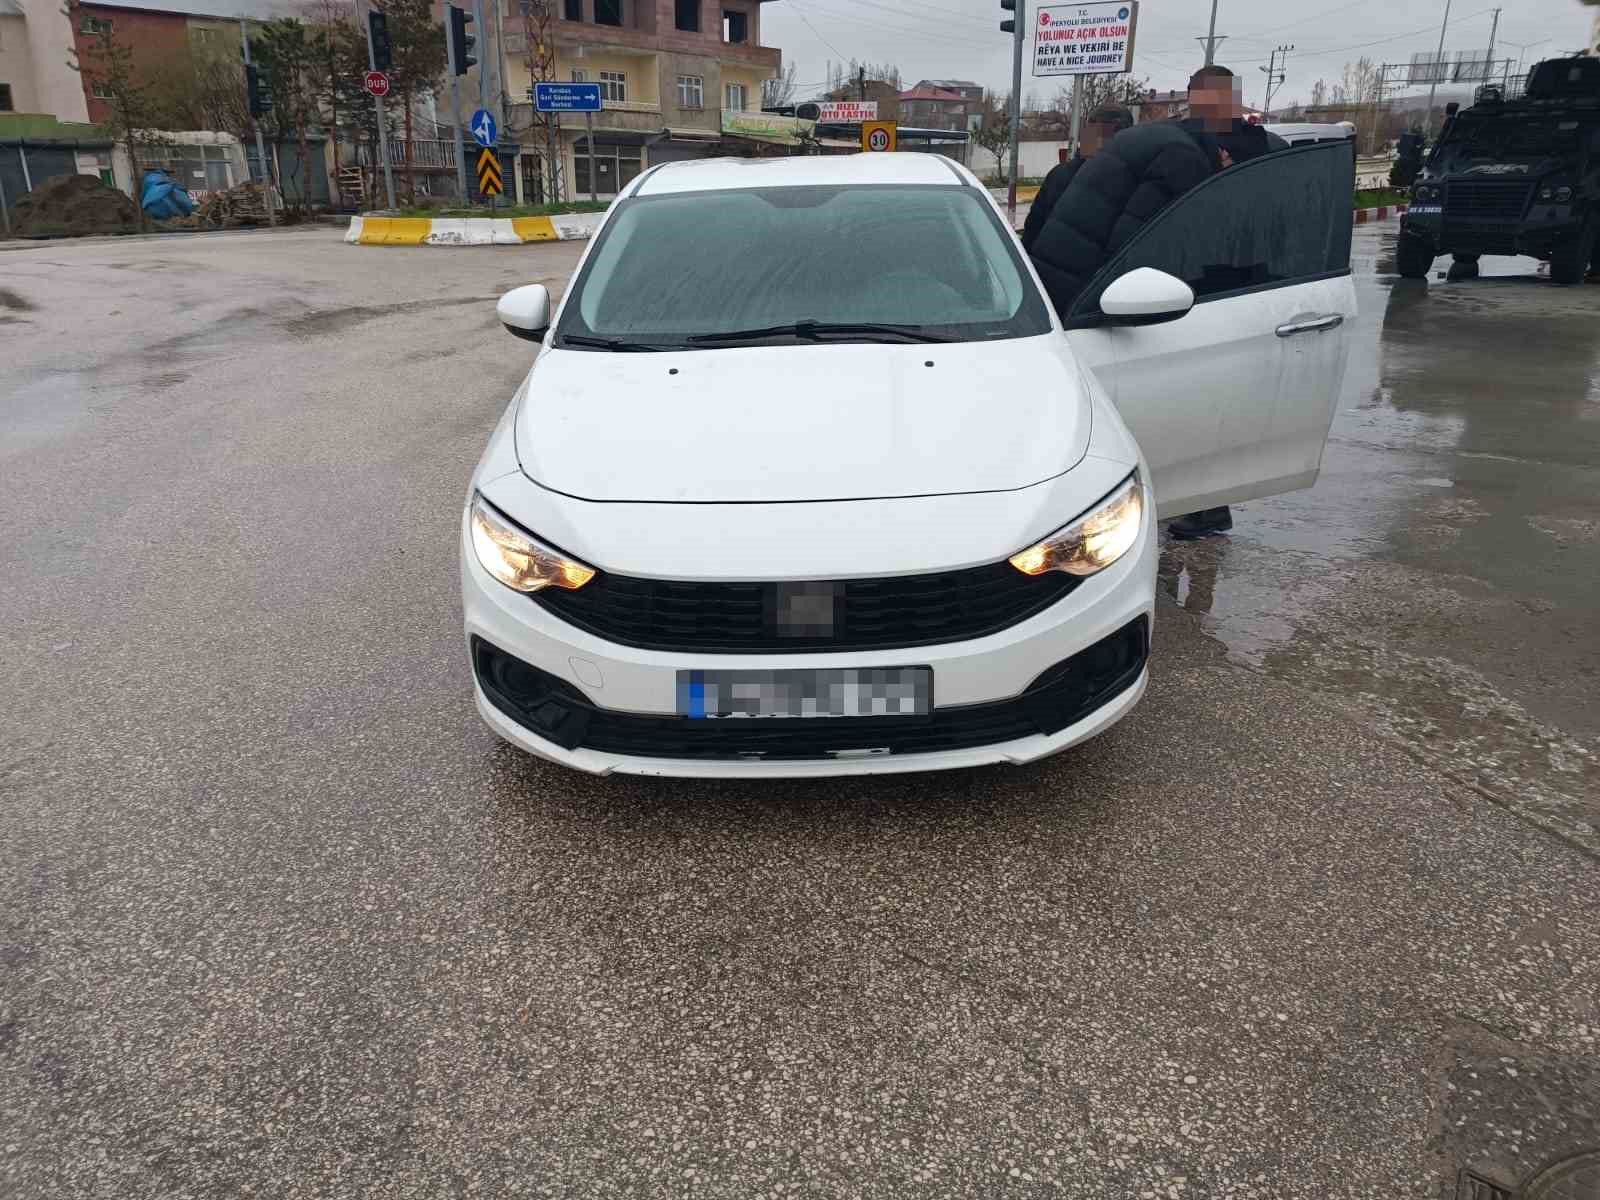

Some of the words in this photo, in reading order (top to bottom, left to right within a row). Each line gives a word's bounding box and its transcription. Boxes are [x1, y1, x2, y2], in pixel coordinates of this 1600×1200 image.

[1038, 28, 1075, 41] YOLUNUZ
[1076, 27, 1097, 42] AÇIK
[1099, 26, 1127, 37] OLSUN
[1038, 43, 1061, 55] RÊYA
[1063, 44, 1077, 54] WE
[1112, 41, 1125, 51] BE
[1037, 57, 1057, 66] HAVE
[1058, 56, 1064, 66] A
[1066, 55, 1086, 65] NICE
[1086, 53, 1122, 65] JOURNEY
[367, 79, 386, 88] DUR
[821, 111, 839, 119] OTO
[872, 134, 886, 146] 30
